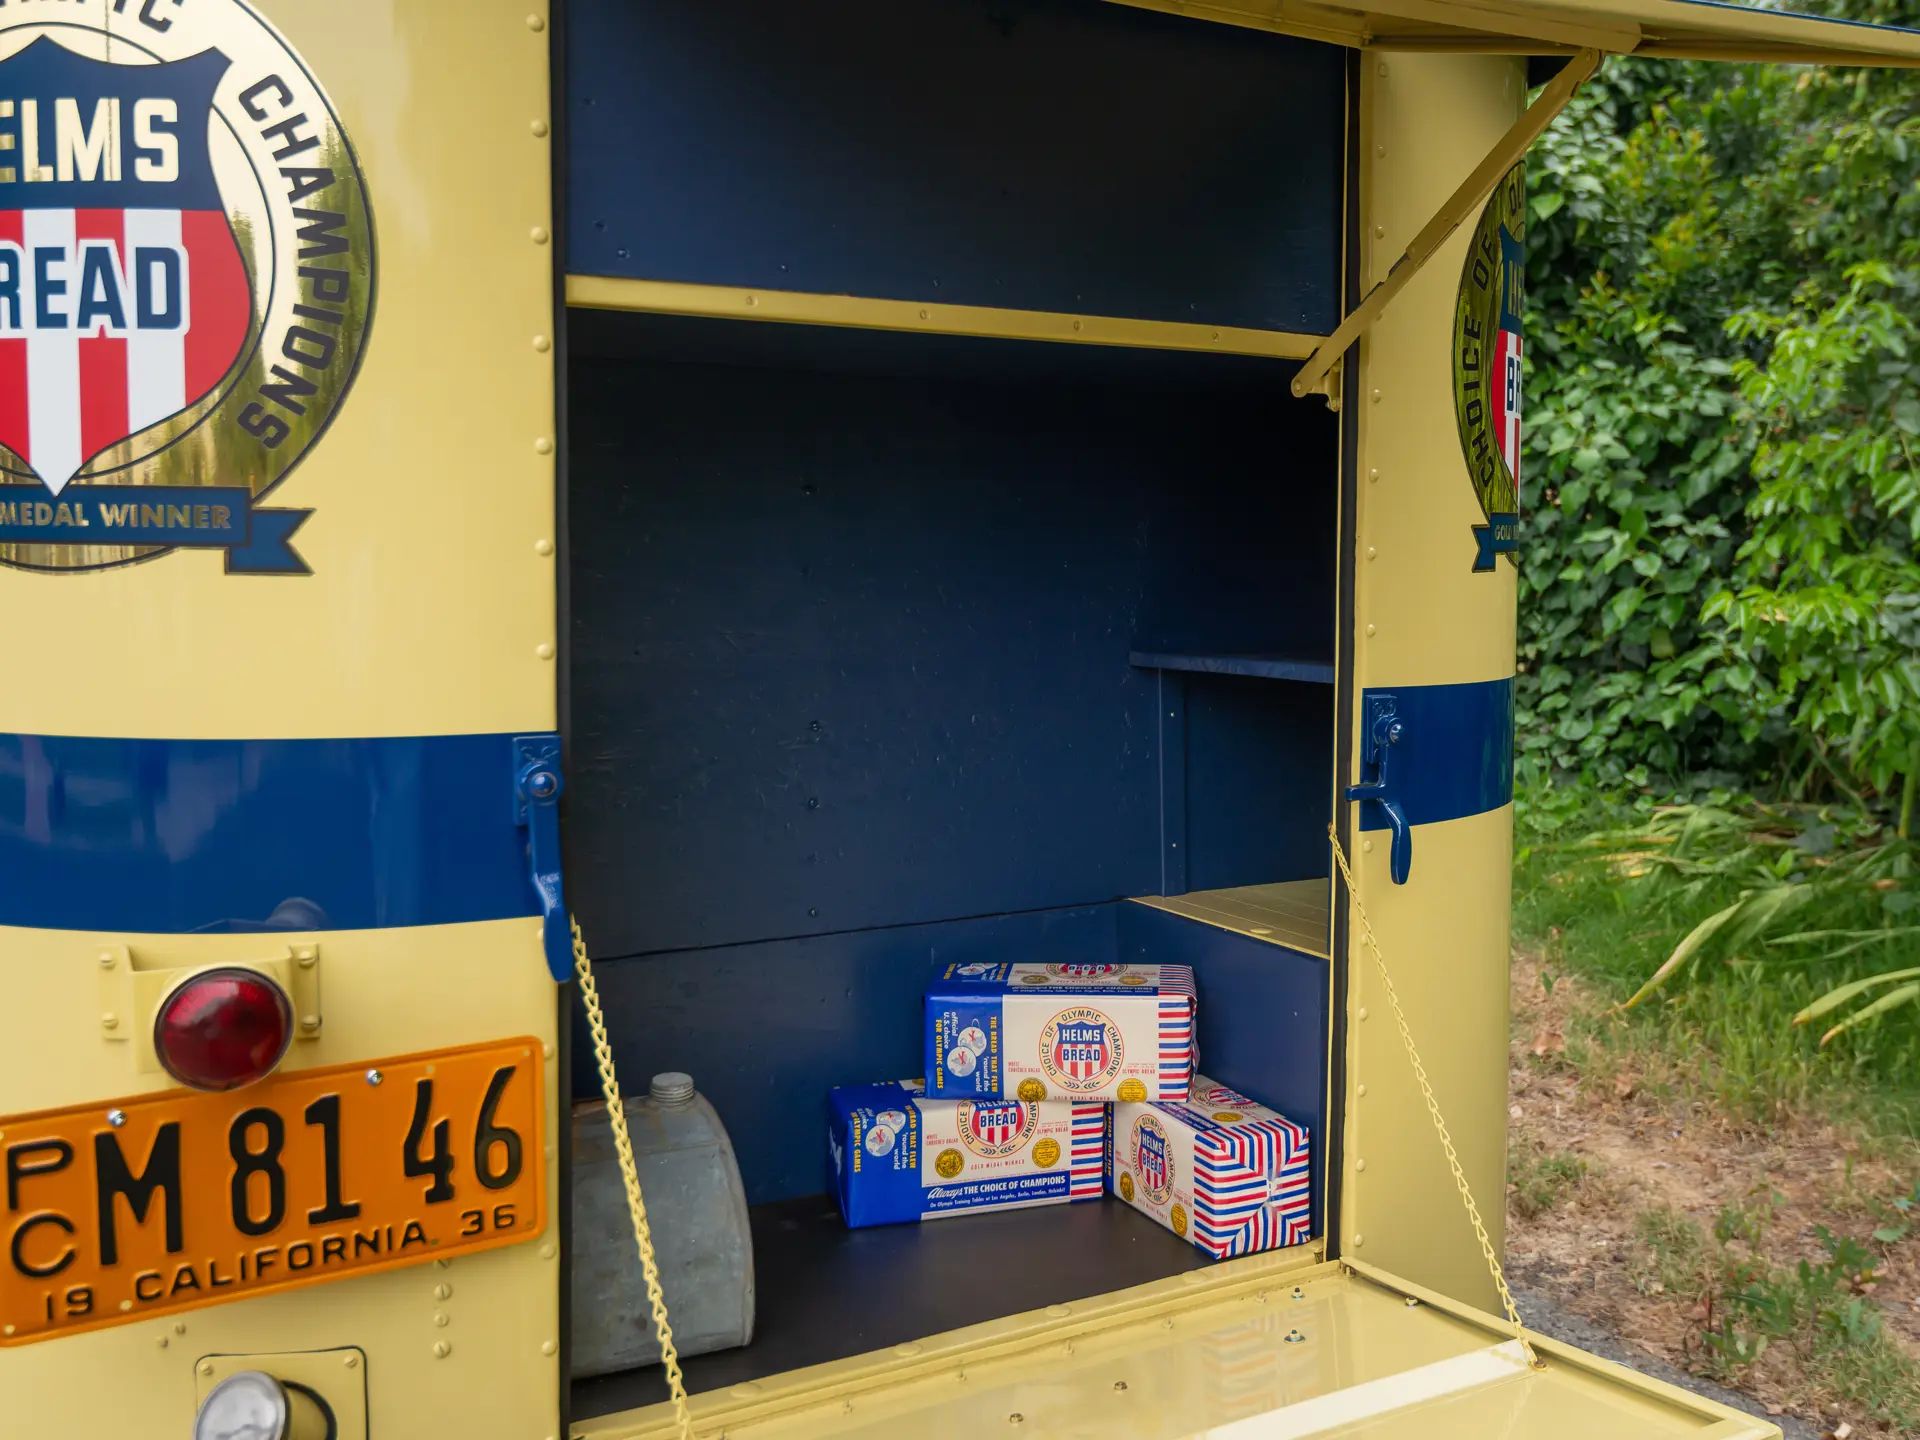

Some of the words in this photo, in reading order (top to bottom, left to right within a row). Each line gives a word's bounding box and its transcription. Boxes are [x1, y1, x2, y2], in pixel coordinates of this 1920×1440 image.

[238, 74, 350, 449] CHAMPIONS
[1472, 231, 1496, 292] OF
[1462, 318, 1495, 488] CHOICE
[0, 502, 90, 527] MEDAL
[100, 502, 232, 529] WINNER
[1062, 1010, 1101, 1022] OLYMPIC
[943, 1027, 951, 1049] choice
[990, 1031, 998, 1053] BREAD
[1045, 1025, 1054, 1038] OF
[1062, 1029, 1101, 1042] HELMS
[1041, 1042, 1057, 1077] CHOICE
[1062, 1048, 1100, 1061] BREAD
[1106, 1026, 1122, 1077] CHAMPIONS
[936, 1067, 944, 1089] GAMES
[975, 1071, 983, 1092] world
[983, 1080, 991, 1092] the
[959, 1111, 975, 1145] CHOICE
[980, 1112, 1017, 1128] BREAD
[1142, 1117, 1163, 1135] OLYMPIC
[909, 1131, 917, 1148] THAT
[1142, 1133, 1163, 1155] HELMS
[853, 1149, 861, 1173] GAMES
[1142, 1153, 1163, 1175] BREAD
[927, 1187, 963, 1199] Always
[963, 1186, 979, 1195] THE
[980, 1182, 1007, 1193] CHOICE
[1008, 1180, 1019, 1190] OF
[1020, 1175, 1066, 1188] CHAMPIONS
[937, 1200, 953, 1208] Olympic
[46, 1285, 94, 1322] 19
[135, 1221, 427, 1301] CALIFORNIA
[461, 1204, 517, 1237] 36
